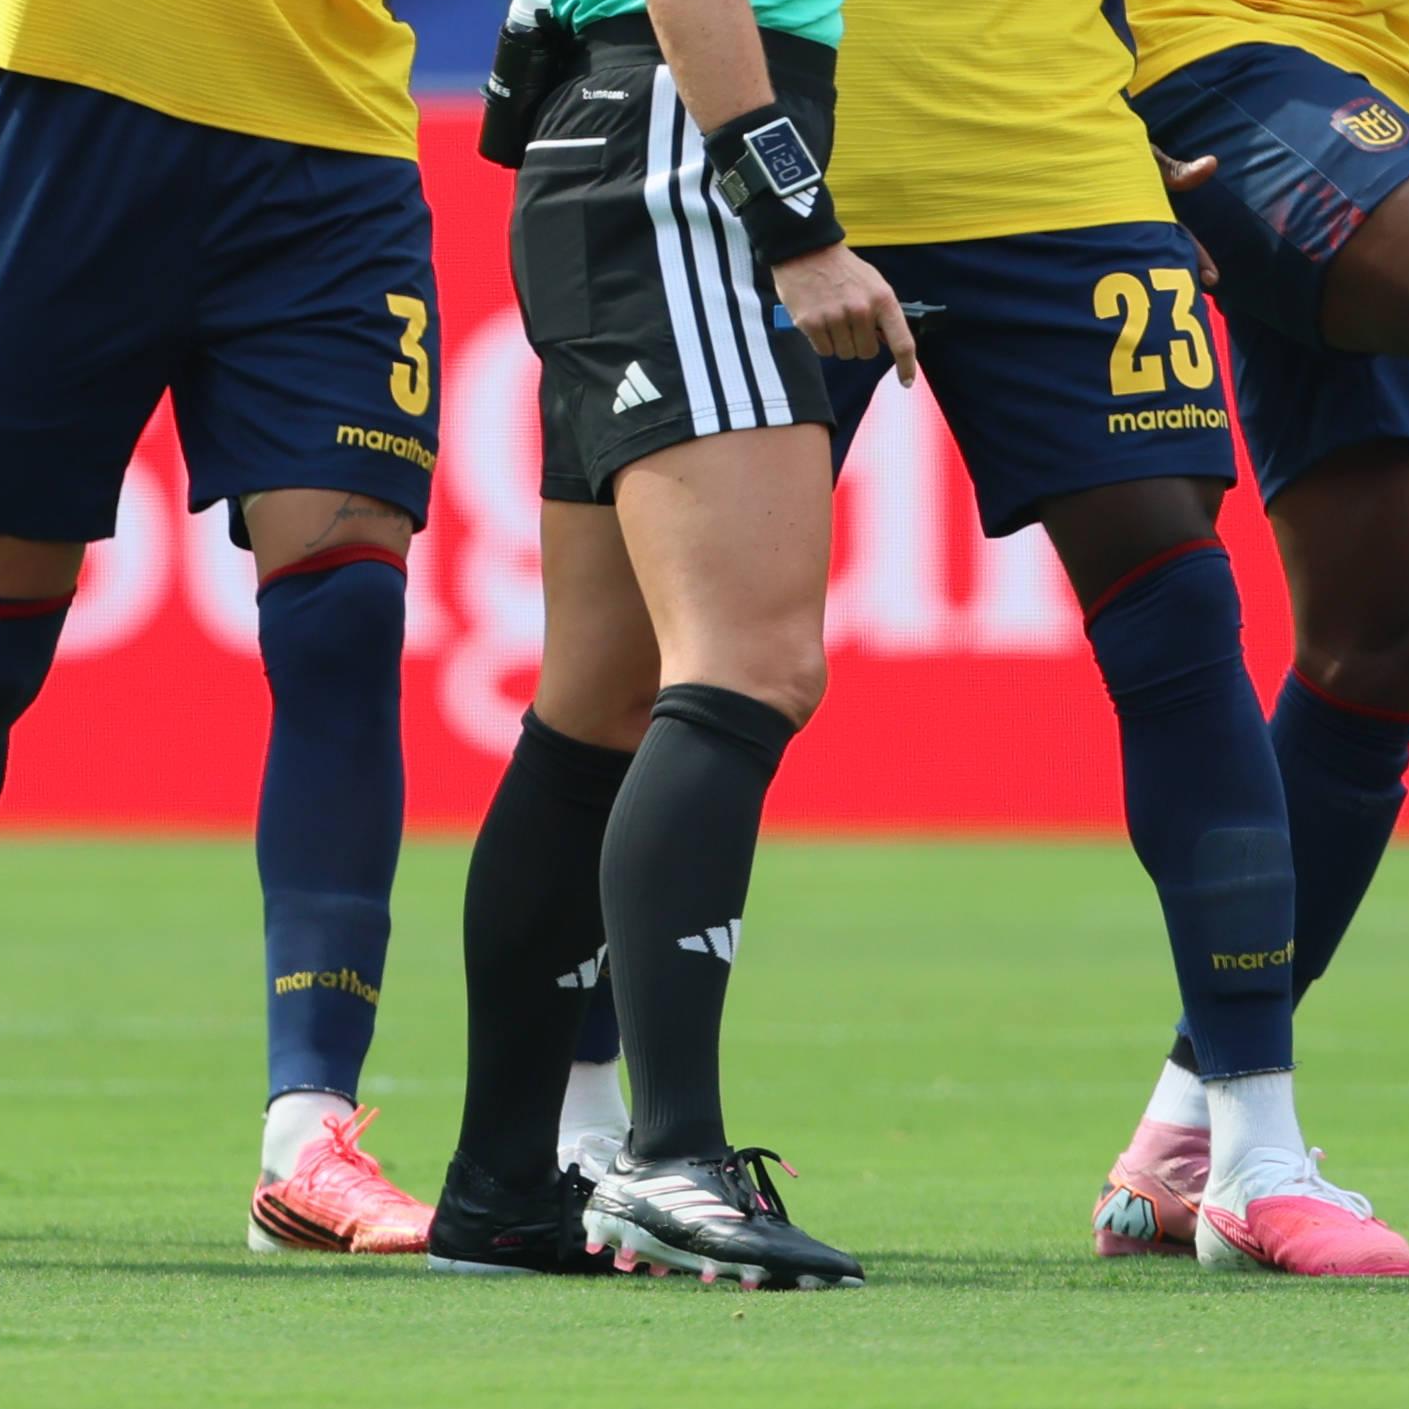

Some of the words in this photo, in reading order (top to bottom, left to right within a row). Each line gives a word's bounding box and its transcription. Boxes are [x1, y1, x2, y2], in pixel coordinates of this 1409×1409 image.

[386, 293, 430, 416] 3
[1094, 268, 1214, 395] 23
[1108, 403, 1229, 433] marathon
